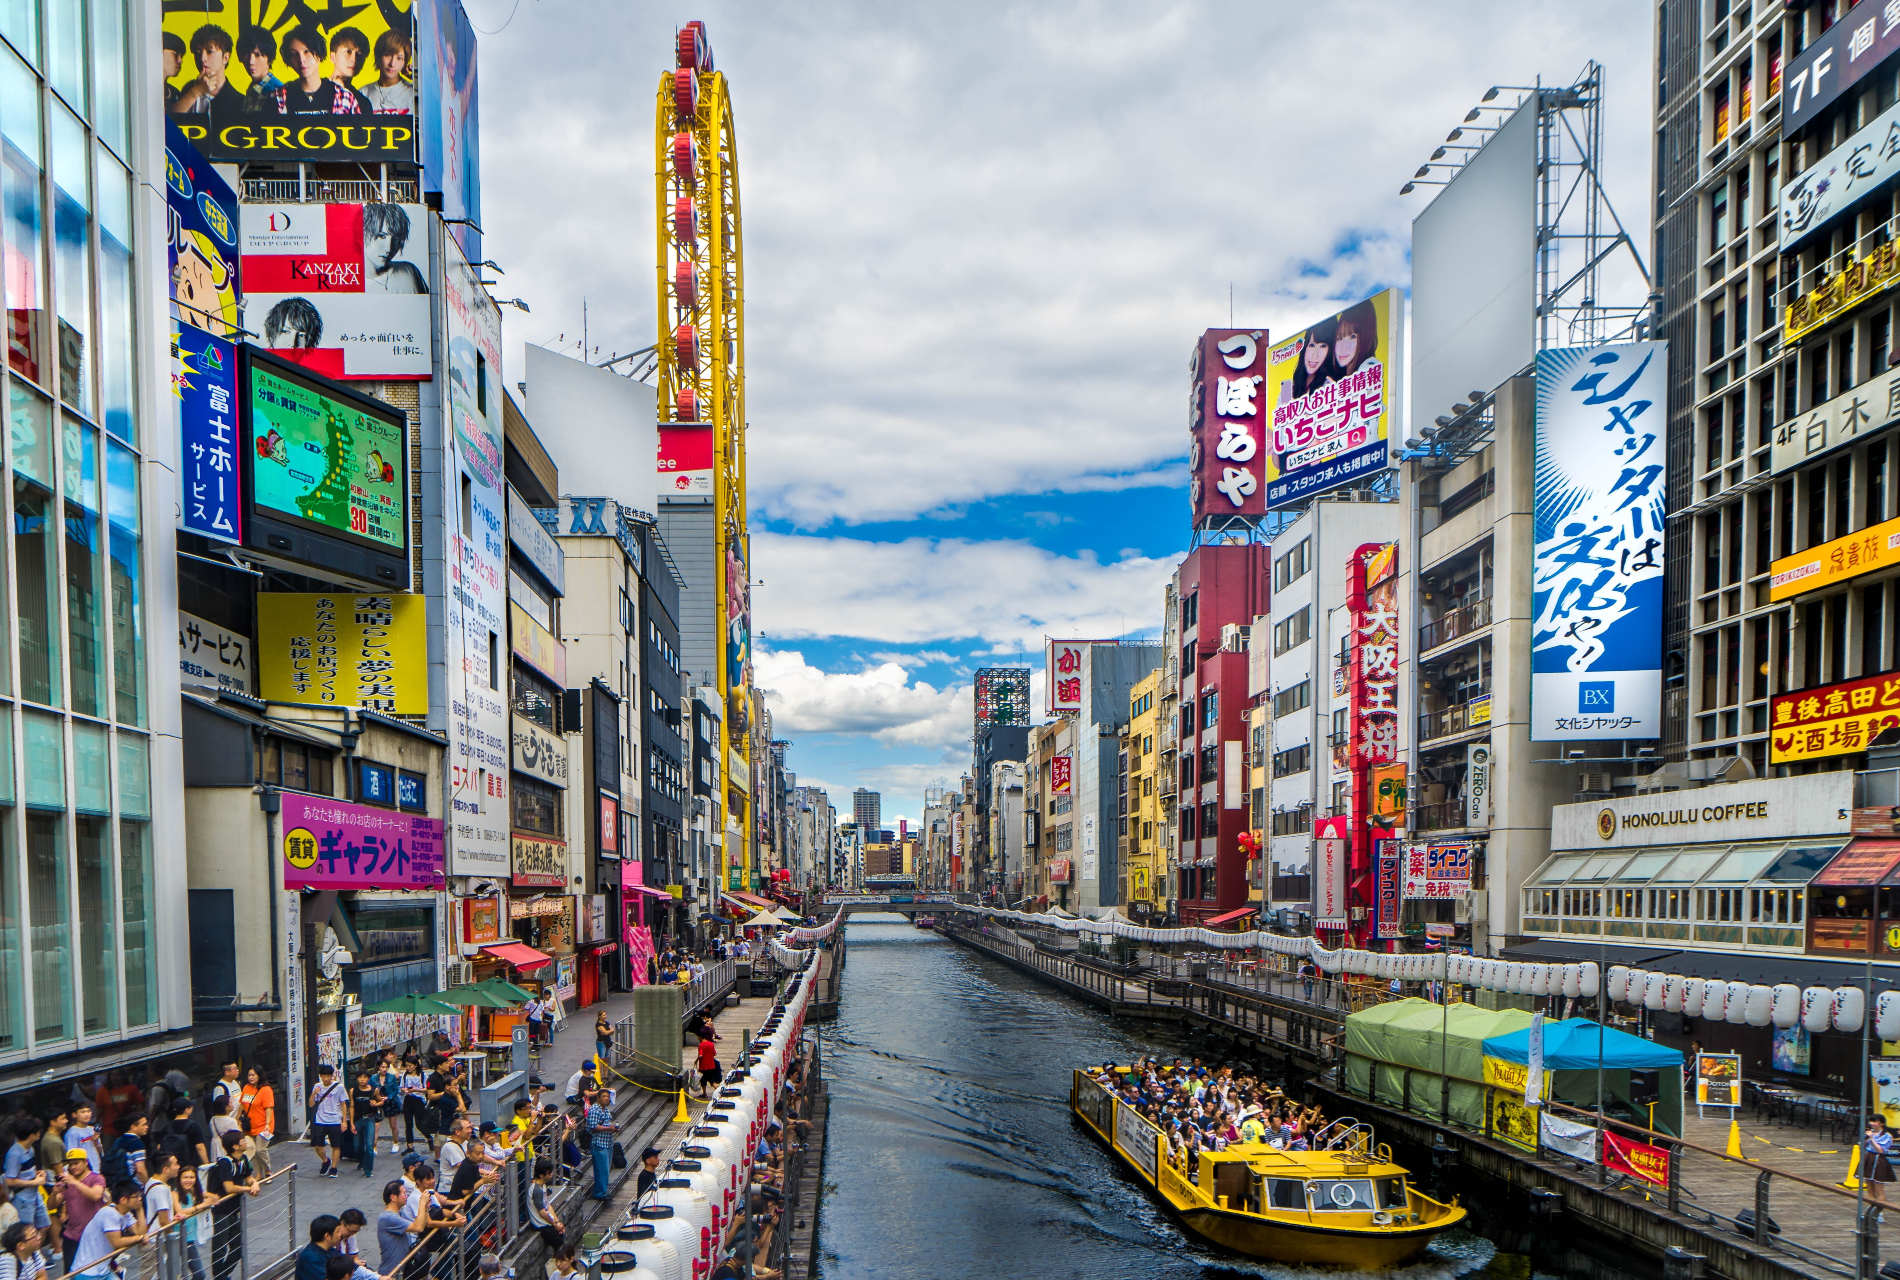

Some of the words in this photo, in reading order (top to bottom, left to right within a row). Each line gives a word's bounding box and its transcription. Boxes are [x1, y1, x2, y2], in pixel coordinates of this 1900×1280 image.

[1789, 46, 1833, 115] 7F
[219, 126, 412, 150] GROUP
[289, 260, 360, 280] KANZAKI
[317, 272, 361, 290] RUKA
[340, 333, 414, 343] めっちゃ面白いを
[392, 346, 425, 356] 仕事に。
[267, 379, 309, 402] 富士ホームサービス
[1274, 363, 1383, 425] 高収入お仕事情報
[1216, 330, 1264, 507] づぼらや
[1272, 384, 1383, 453] いちごナビ
[1776, 421, 1798, 446] 4F
[208, 382, 234, 533] 富士ホーム
[1289, 447, 1325, 468] いちごナビ
[1327, 439, 1344, 454] 求人
[191, 441, 207, 521] サービス
[350, 506, 368, 534] 30
[1828, 533, 1880, 576] 鳥貴族
[289, 636, 313, 695] 応援します
[315, 598, 339, 703] あなたのお店づくり
[353, 596, 397, 713] 素晴らしい夢の実現
[1357, 602, 1399, 761] 大阪王将
[1583, 688, 1611, 706] BX
[1796, 720, 1864, 753] 酒場
[522, 727, 555, 779] うなぎ
[369, 770, 380, 797] 酒
[453, 764, 479, 792] コスパ
[1053, 762, 1061, 786] ドラッグ
[1060, 758, 1069, 781] ツルハ
[1473, 765, 1484, 797] ZERO
[398, 777, 418, 804] たばこ
[1621, 809, 1698, 830] HONOLULU
[1702, 801, 1769, 822] COFFEE
[289, 836, 315, 860] 賃貸
[316, 863, 323, 875] の
[319, 828, 411, 876] ギャラント
[525, 842, 553, 877] お好み焼
[1409, 846, 1425, 878] 薬
[1428, 847, 1470, 868] ダイコク
[1381, 859, 1396, 900] ダイコク
[1425, 881, 1450, 897] 免税
[1378, 923, 1398, 932] 免税
